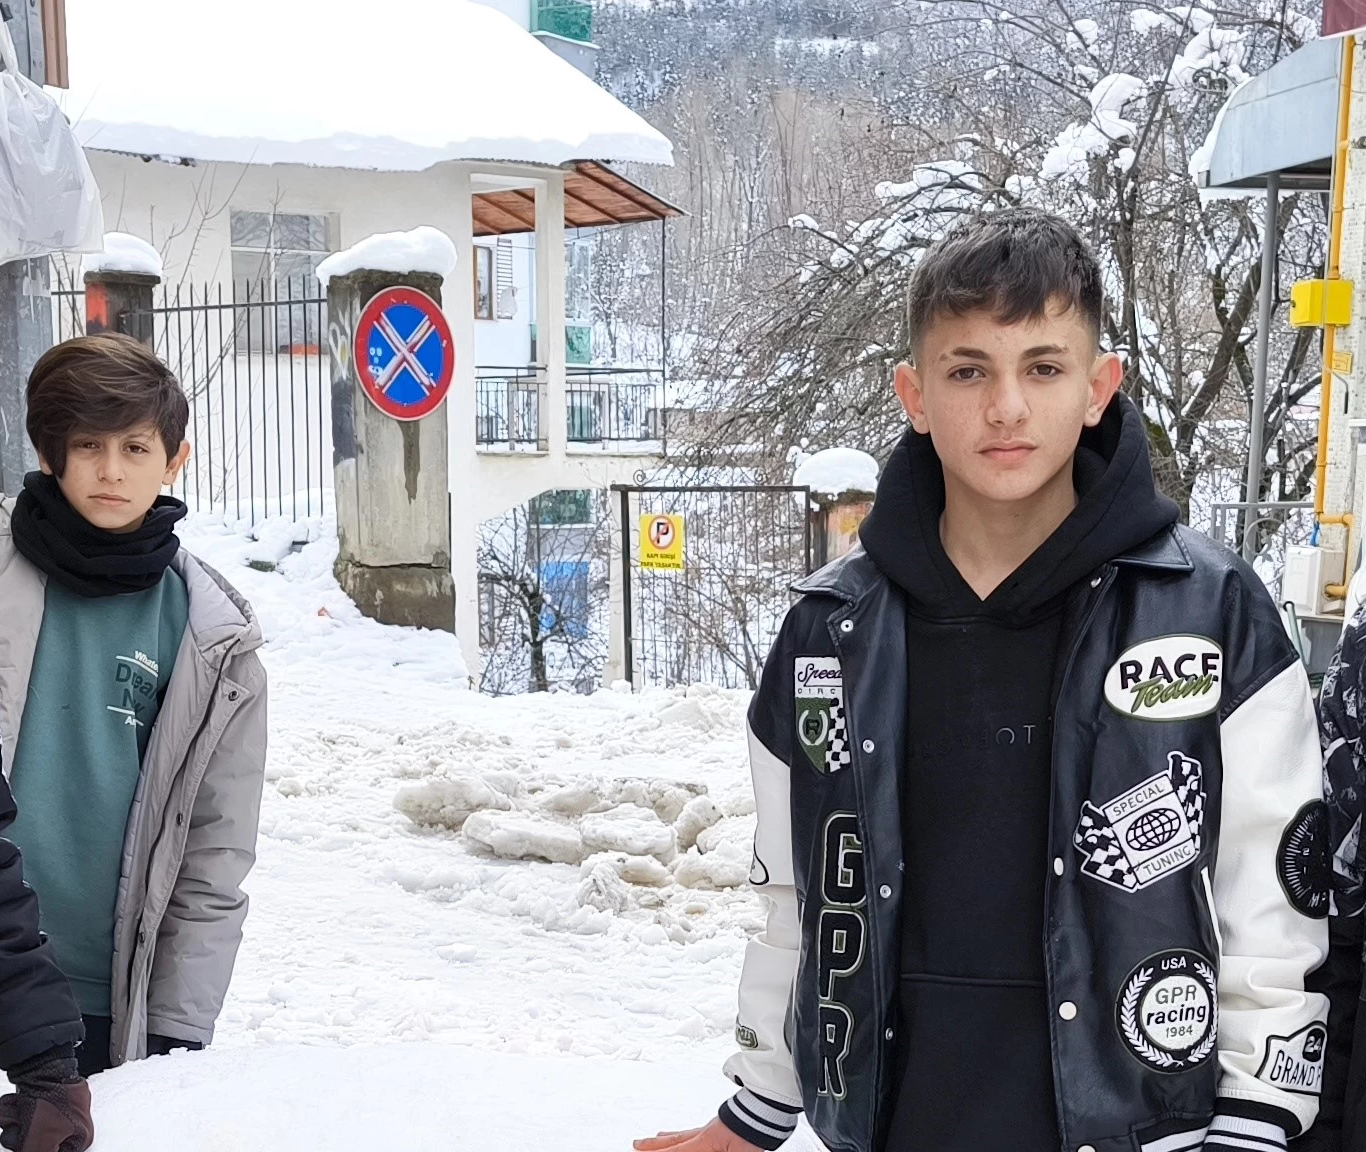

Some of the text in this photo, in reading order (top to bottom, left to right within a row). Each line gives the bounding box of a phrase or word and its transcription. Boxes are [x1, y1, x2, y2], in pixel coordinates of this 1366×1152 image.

[1119, 652, 1220, 690] RACE
[1129, 673, 1214, 715] Team
[1112, 783, 1166, 817] SPECIAL
[1142, 845, 1192, 876] TUNING
[1161, 956, 1187, 970] USA
[1155, 984, 1197, 1005] GPR
[1146, 1004, 1206, 1026] racing
[1269, 1048, 1315, 1087] GRAND
